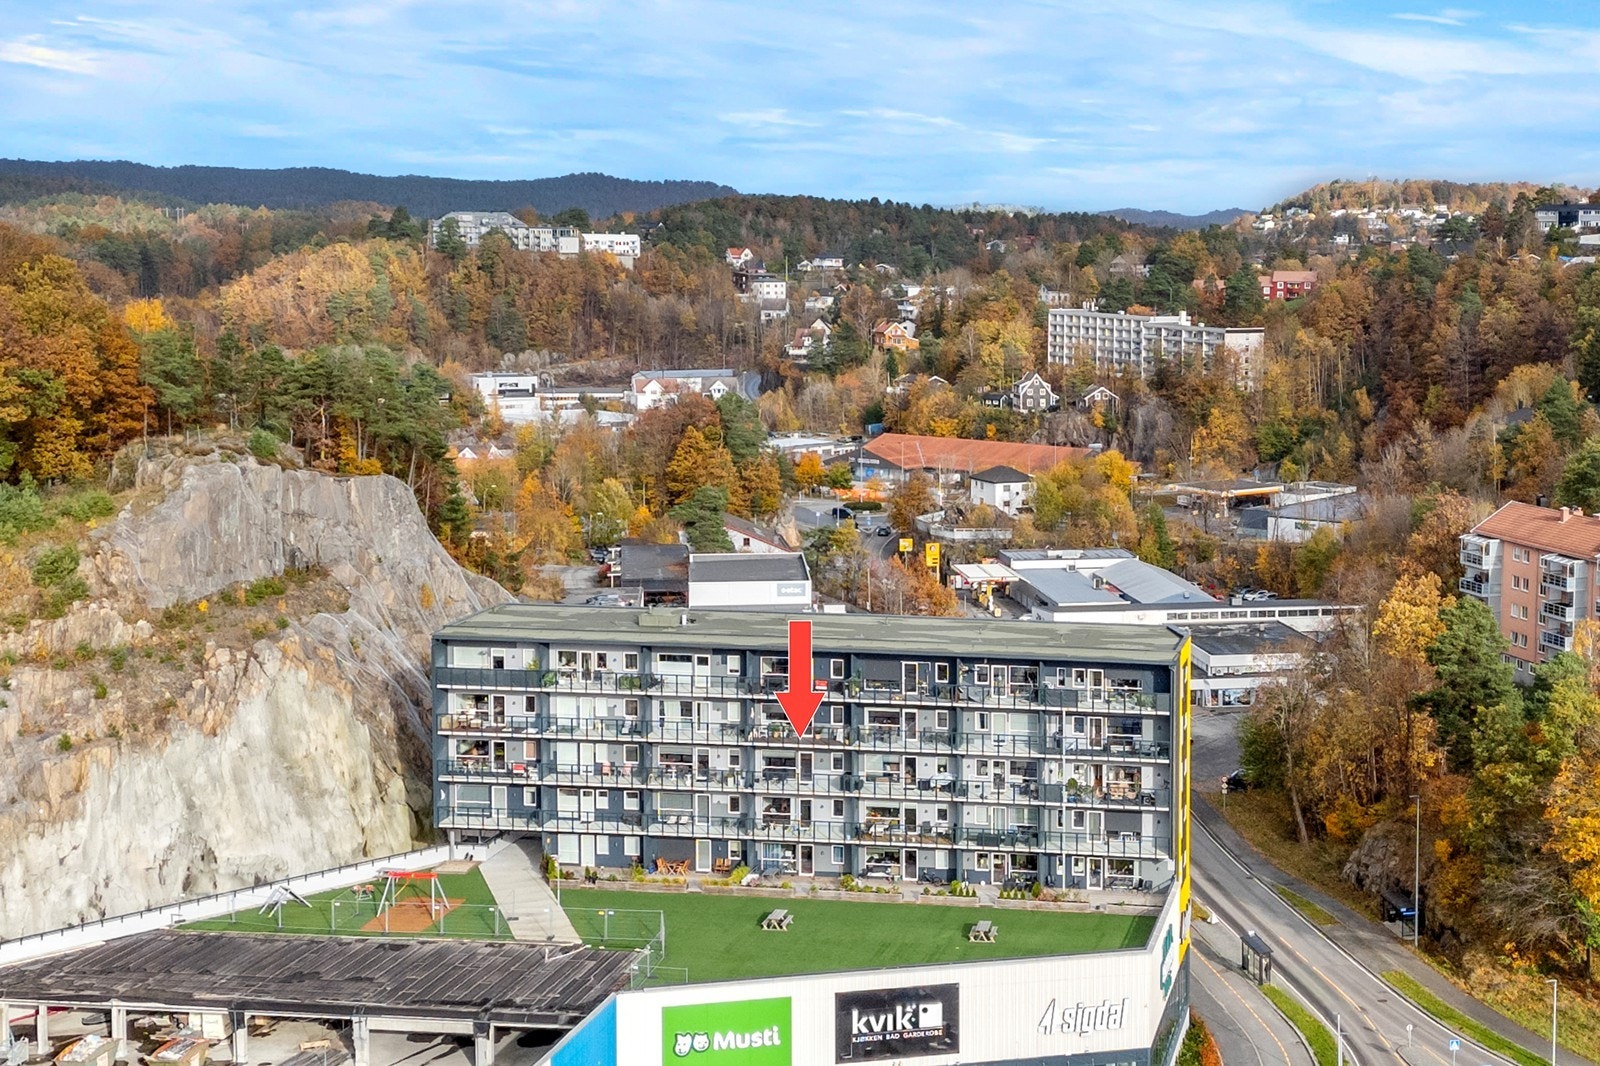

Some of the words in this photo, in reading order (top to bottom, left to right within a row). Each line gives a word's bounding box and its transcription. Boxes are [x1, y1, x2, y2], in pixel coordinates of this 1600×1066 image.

[852, 1005, 913, 1034] kvik
[1061, 997, 1129, 1037] sigdal
[713, 1025, 781, 1051] Musti
